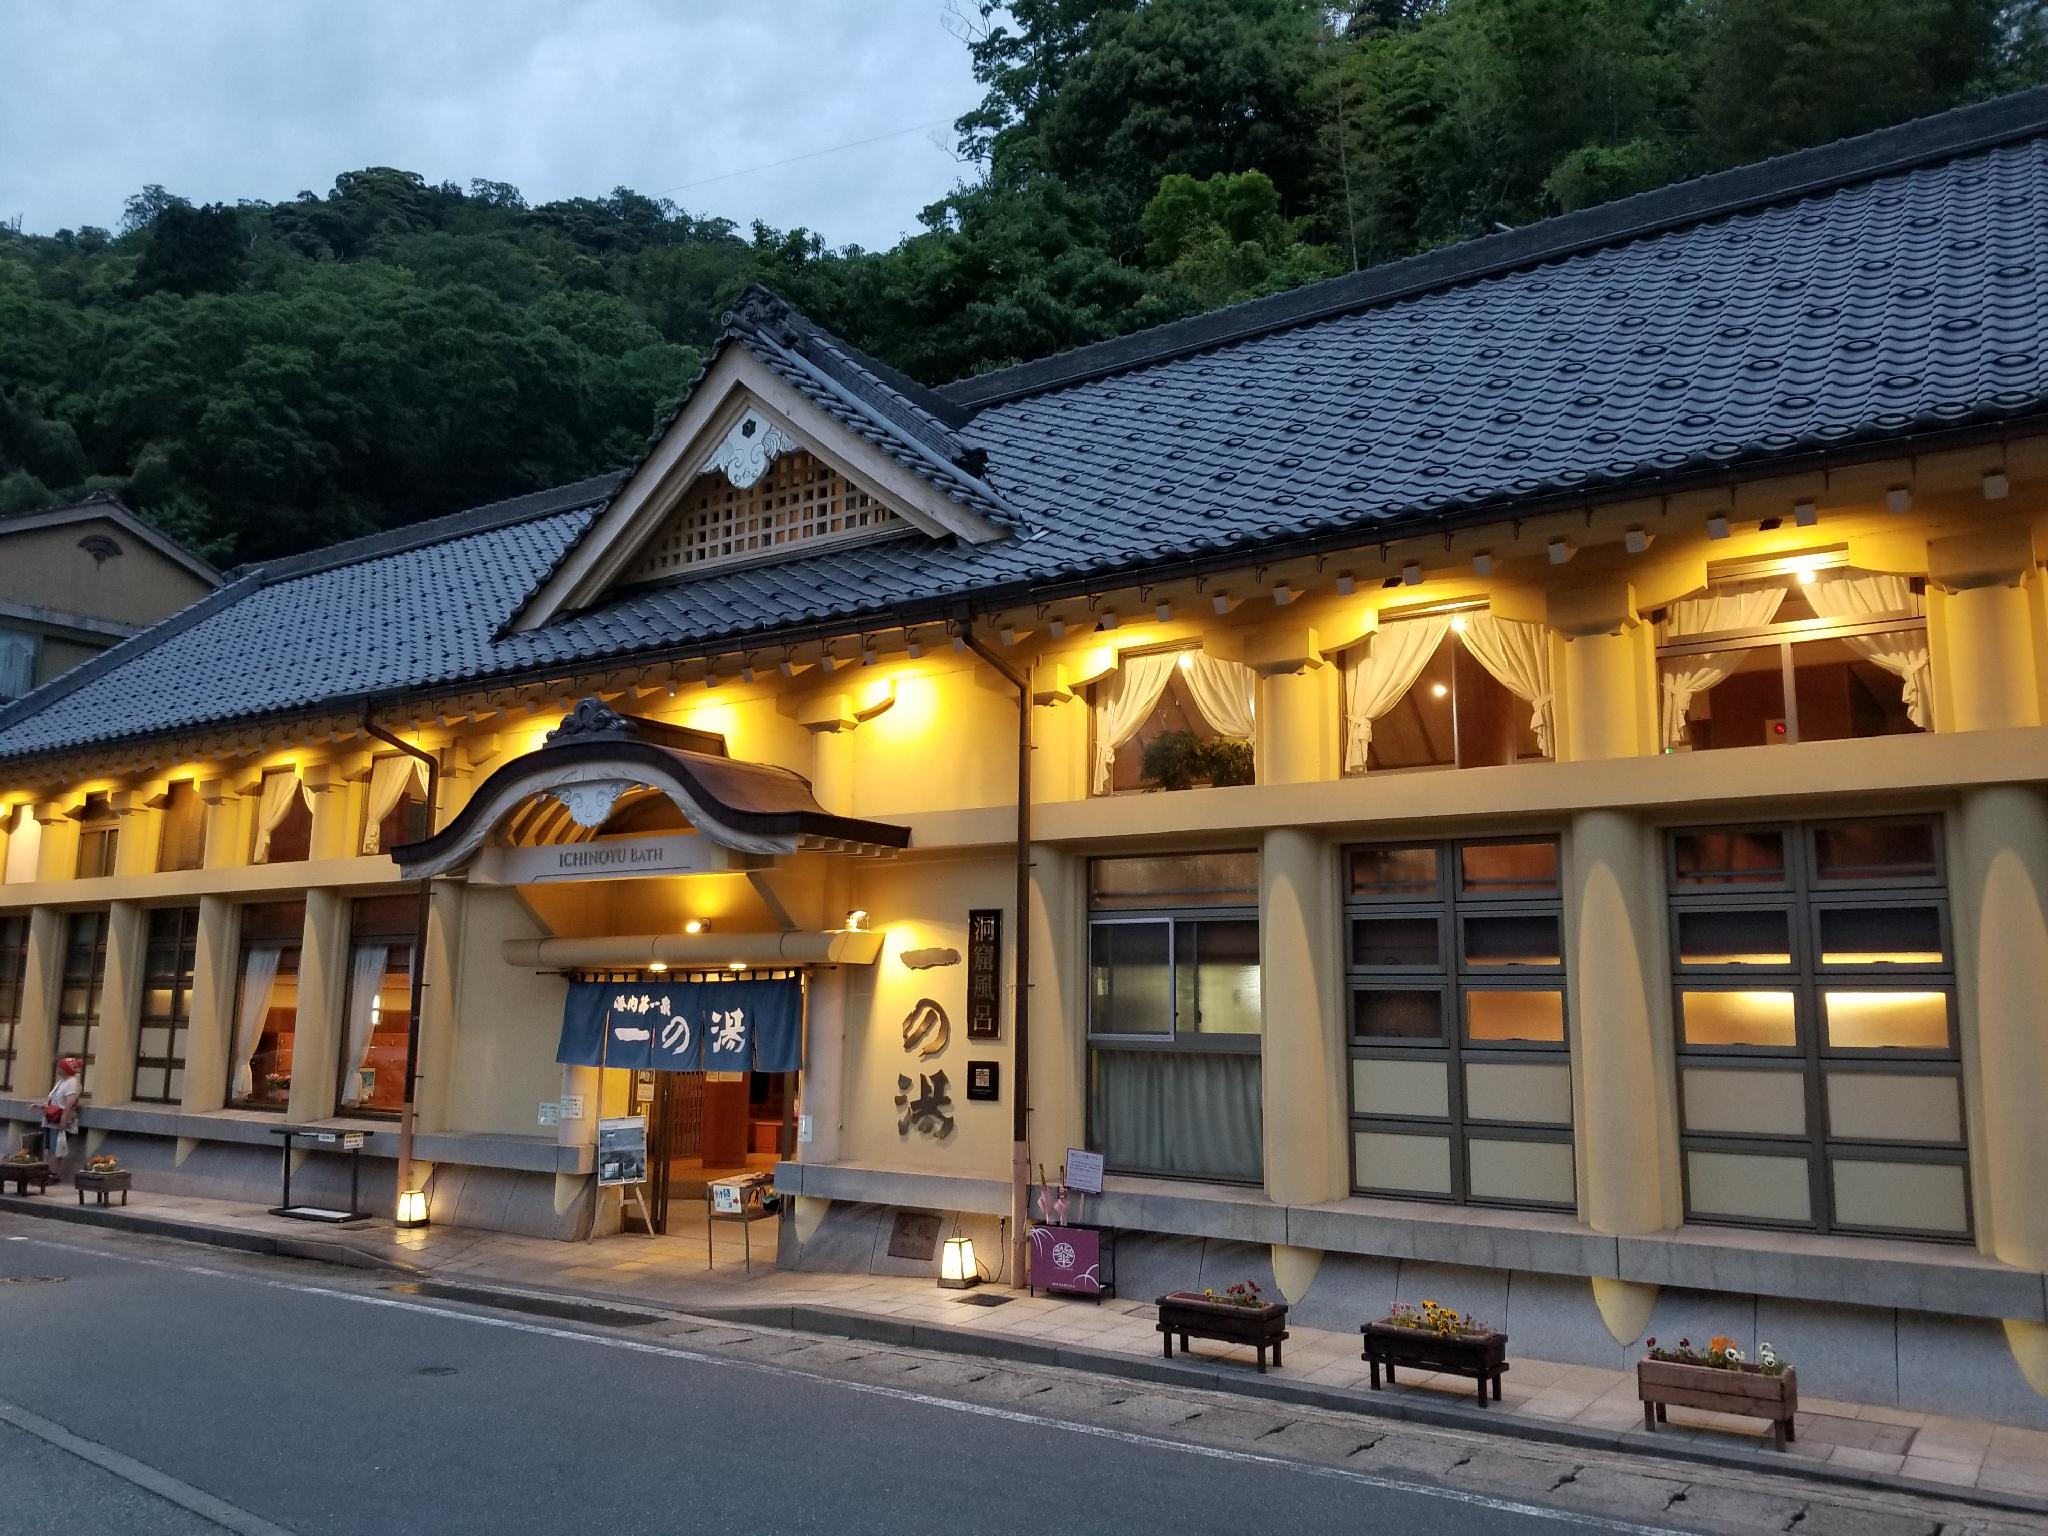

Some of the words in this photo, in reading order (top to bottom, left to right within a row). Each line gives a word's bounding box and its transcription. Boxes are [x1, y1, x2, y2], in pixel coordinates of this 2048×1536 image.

[559, 848, 626, 868] ICHINOYU
[630, 847, 663, 863] BATH
[973, 915, 995, 1032] 洞窟風呂
[613, 1007, 746, 1056] 一の湯
[895, 947, 961, 1140] 一の湯
